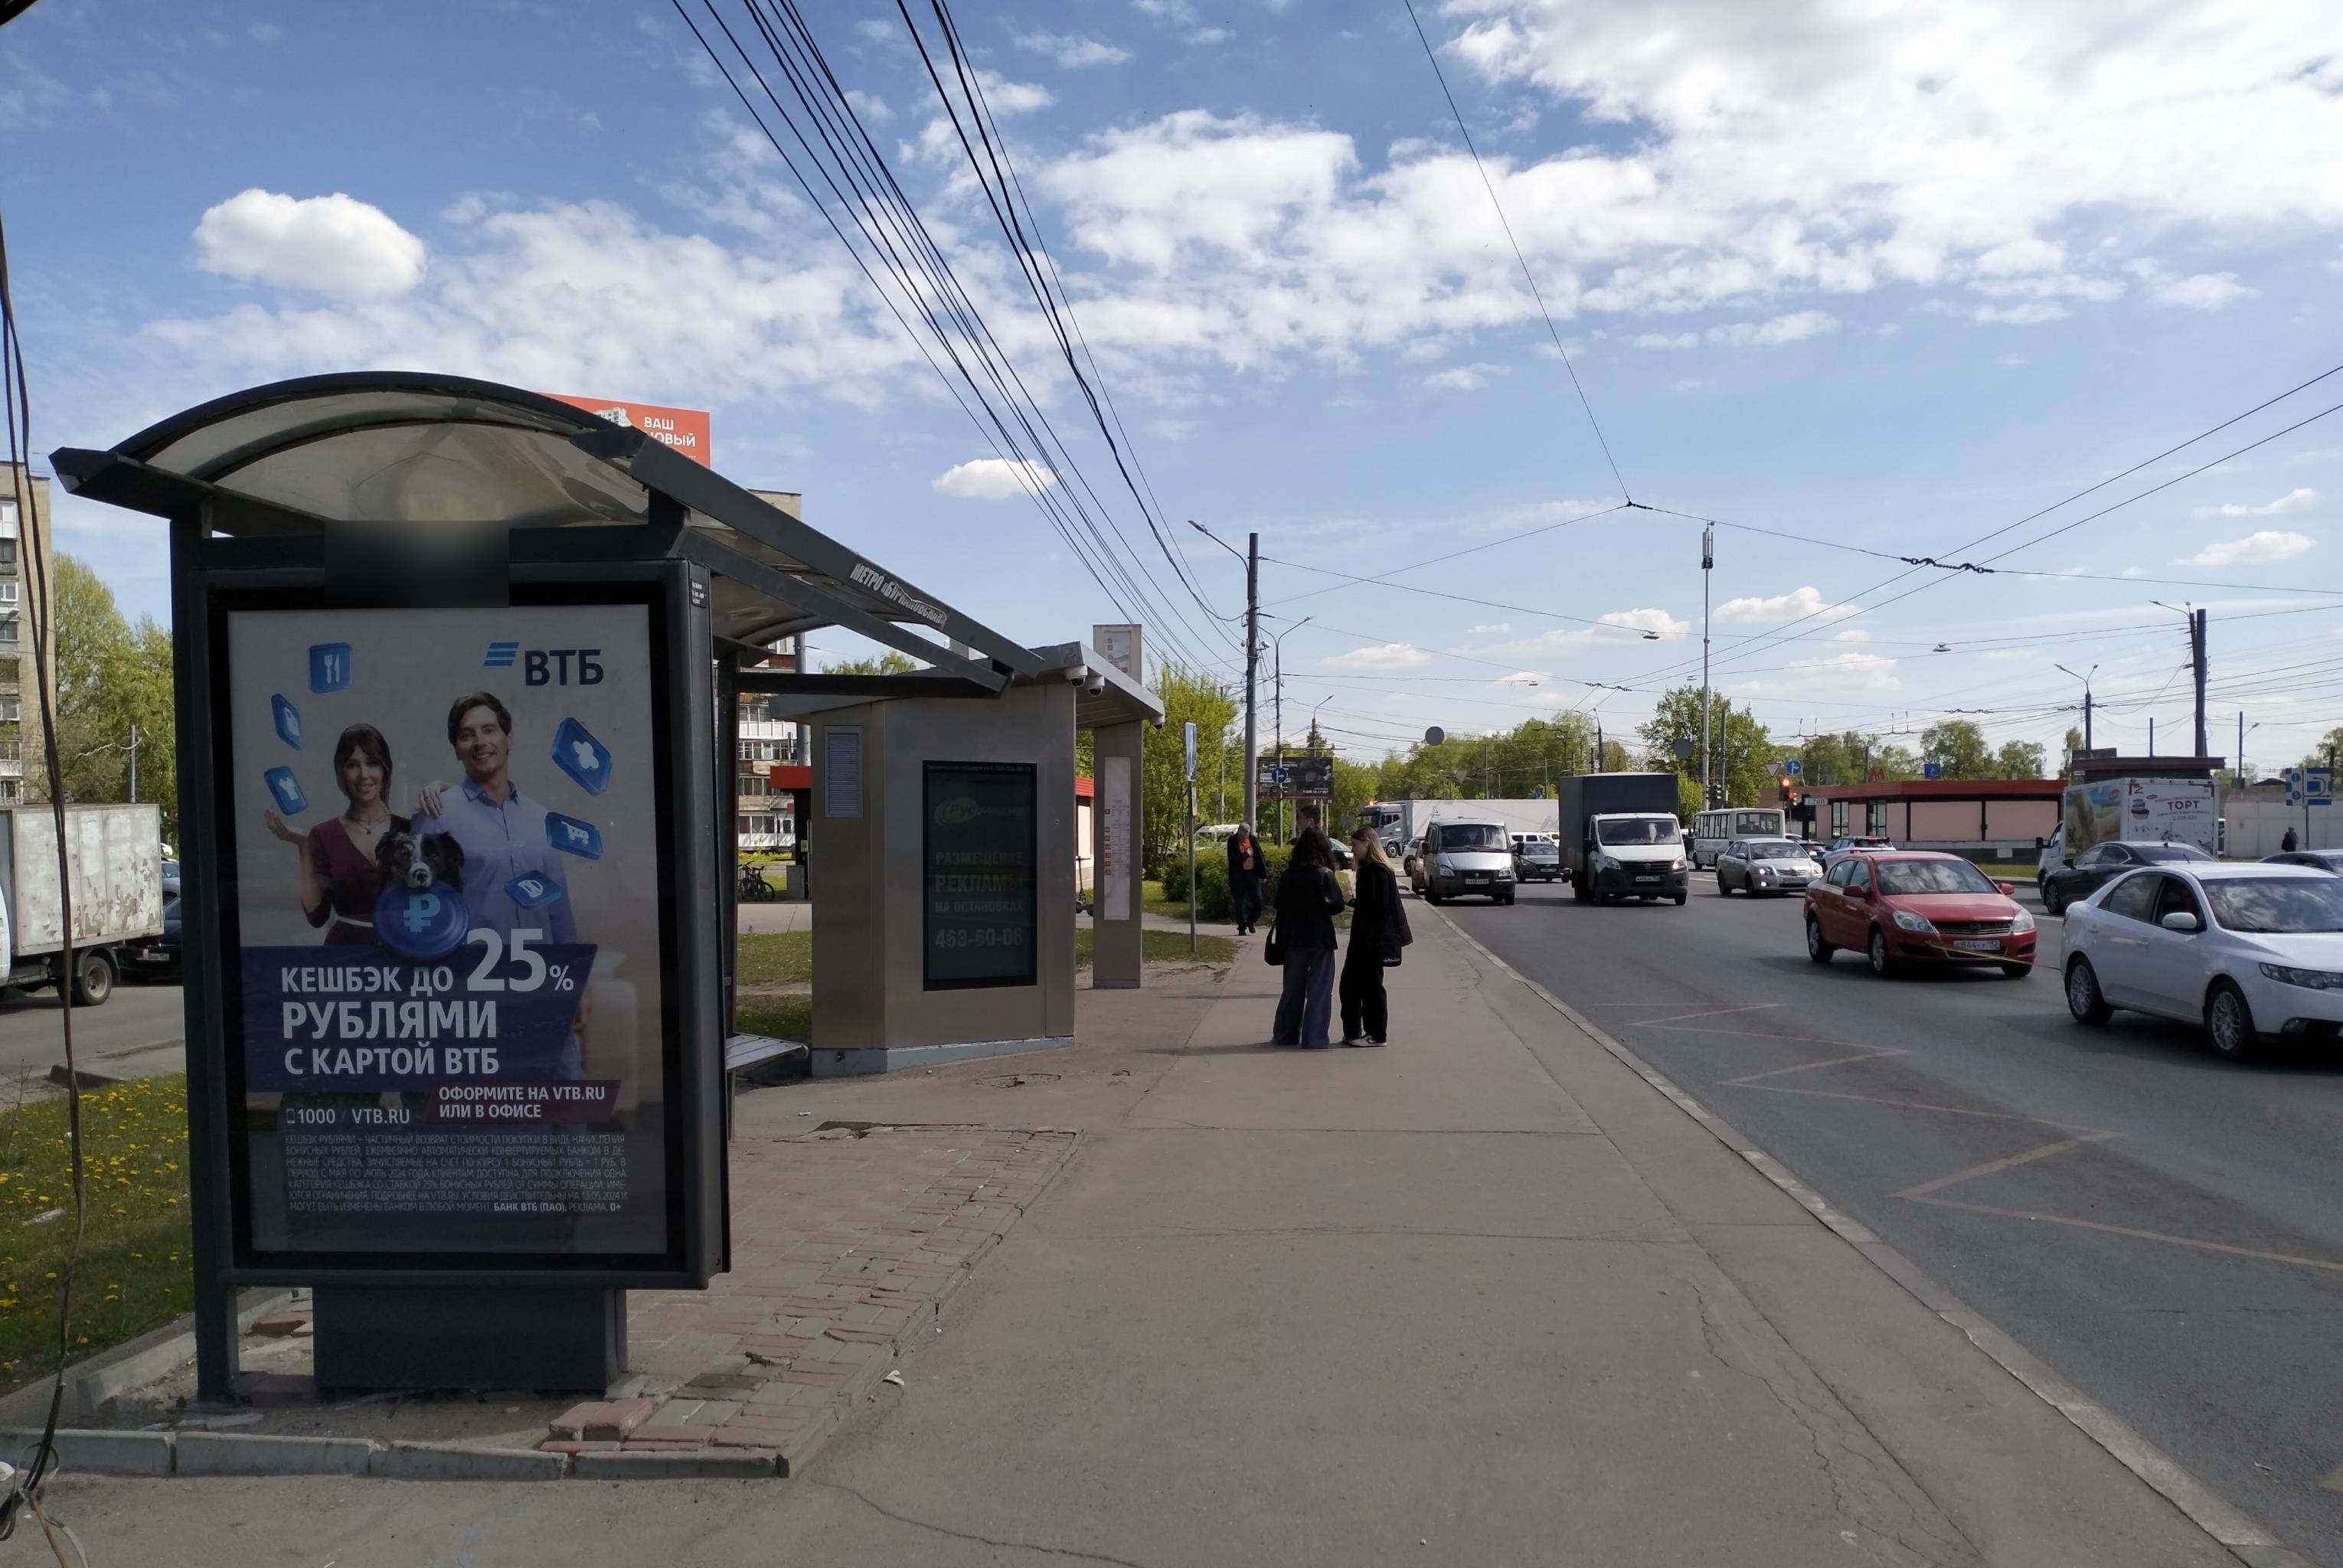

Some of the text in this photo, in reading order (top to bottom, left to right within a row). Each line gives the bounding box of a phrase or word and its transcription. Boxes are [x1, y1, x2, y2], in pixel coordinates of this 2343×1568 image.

[644, 416, 674, 430] ВАШ
[849, 563, 884, 591] МЕТРО
[524, 649, 604, 686] ВТБ
[2168, 801, 2200, 810] ТОРТ
[935, 851, 1023, 867] РАЗМЕЩЕНИЕ
[935, 874, 1023, 892] РЕКЛАМЫ
[935, 900, 1024, 913] НА ОСТАНОВКАХ
[281, 928, 574, 997] КЕШБЭК ДО 25%
[283, 1001, 497, 1040] РУБЛЯМИ
[284, 1040, 499, 1075] С КАРТОЙ ВТБ
[438, 1086, 606, 1102] ОФОРМИТЕ НА VTB.RU
[297, 1109, 410, 1125] 1000 VTB.RU
[439, 1104, 542, 1119] ИЛИ В ОФИСЕ
[285, 1135, 318, 1145] КЕШБЭК
[319, 1135, 355, 1145] РУБЛЯМИ
[365, 1135, 412, 1145] ЧАСТИЧНЫЙ
[416, 1135, 448, 1145] ВОЗВРАТ
[452, 1135, 499, 1145] СТОИМОСТИ
[502, 1135, 540, 1145] ПОКУПКИ
[551, 1135, 570, 1145] ВИДЕ
[573, 1135, 624, 1145] НАЧИСЛЕНИЯ
[286, 1146, 328, 1155] БОНУСНЫХ
[365, 1146, 417, 1155] ЕЖЕМЕСЯЧНО
[421, 1146, 489, 1155] АВТОМАТИЧЕСКИ
[492, 1146, 564, 1155] КОНВЕРТИРУЕМЫХ
[567, 1146, 600, 1155] БАНКОМ
[604, 1146, 609, 1155] В
[286, 1158, 319, 1167] НЕЖНЫЕ
[368, 1158, 423, 1167] ЗАЧИСЛЯЕМЫЕ
[426, 1158, 437, 1167] НА
[462, 1158, 474, 1167] ПО
[477, 1158, 502, 1167] КУРСУ
[512, 1158, 555, 1167] БОНУСНЫЙ
[559, 1158, 583, 1167] РУБЛЬ
[621, 1158, 626, 1167] В
[288, 1169, 318, 1178] ПЕРИОД
[322, 1169, 326, 1178] С
[329, 1169, 346, 1178] МАЯ
[349, 1169, 361, 1178] ПО
[390, 1169, 405, 1178] 2024
[408, 1169, 429, 1178] ГОДА
[432, 1169, 473, 1178] КЛИЕНТАМ
[476, 1169, 518, 1178] ДОСТУПНА
[521, 1169, 538, 1178] ДЛЯ
[541, 1169, 600, 1178] ПОДКЛЮЧЕНИЯ
[604, 1169, 626, 1178] ОДНА
[288, 1180, 331, 1189] КАТЕГОРИЯ
[334, 1180, 371, 1189] КЕШБЭКА
[373, 1180, 383, 1189] СО
[386, 1180, 421, 1189] СТАВКОЙ
[440, 1180, 482, 1189] БОНУСНЫХ
[485, 1180, 513, 1189] РУБЛЕЙ
[515, 1180, 524, 1189] ОТ
[528, 1180, 558, 1189] СУММЫ
[289, 1191, 310, 1200] ЮТСЯ
[371, 1191, 417, 1200] ПОДРОБНЕЕ
[419, 1191, 430, 1200] НА
[462, 1191, 498, 1200] УСЛОВИЯ
[501, 1191, 567, 1200] ДЕЙСТВИТЕЛЬНЫ
[569, 1191, 579, 1200] НА
[582, 1191, 619, 1200] 13.05.2024
[290, 1203, 315, 1212] МОГУТ
[318, 1203, 338, 1212] БЫТЬ
[340, 1203, 383, 1212] ИЗМЕНЕНЫ
[385, 1203, 417, 1212] БАНКОМ
[419, 1203, 423, 1212] В
[426, 1203, 454, 1212] ЛЮБОЙ
[494, 1203, 518, 1212] БАНК
[521, 1203, 538, 1212] ВТБ
[540, 1203, 567, 1212] (ПАО).
[569, 1203, 607, 1212] РЕКЛАМА.
[610, 1203, 621, 1212] 0+
